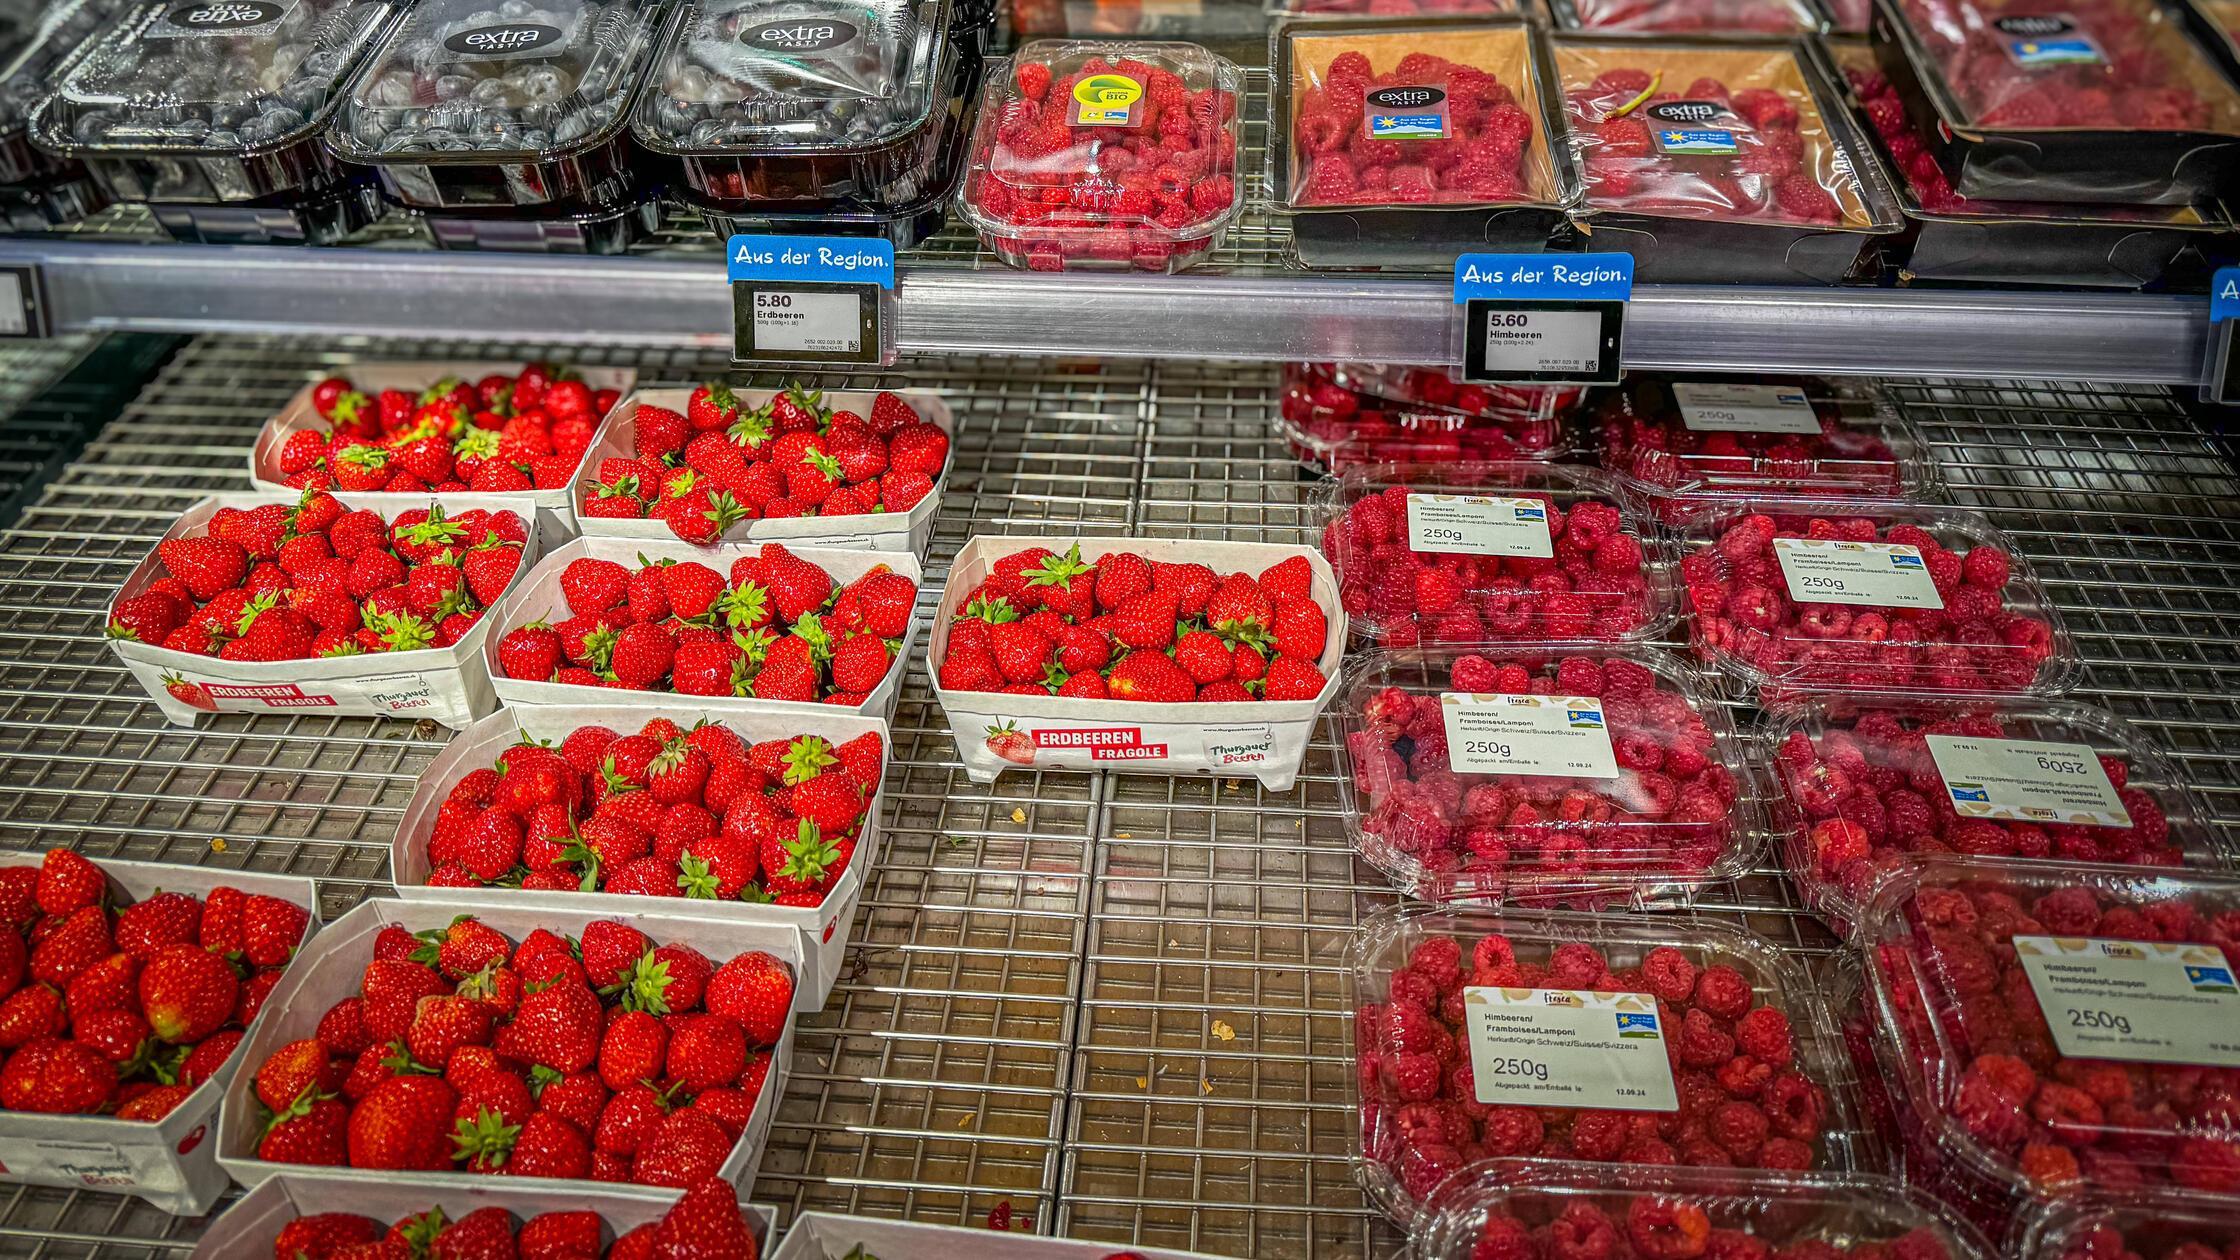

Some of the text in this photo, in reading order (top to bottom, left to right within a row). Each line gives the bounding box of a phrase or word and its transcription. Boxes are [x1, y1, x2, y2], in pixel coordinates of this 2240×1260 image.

[188, 10, 263, 23] extra
[465, 30, 540, 45] extra
[760, 25, 834, 40] extra
[480, 42, 524, 50] TASTY
[1378, 90, 1430, 102] extra
[1659, 104, 1713, 116] extra
[734, 244, 889, 270] Aus der Region.
[1462, 264, 1627, 286] Aus der Region.
[757, 294, 792, 308] 5.80
[757, 310, 805, 320] Erdbeeren
[1491, 314, 1528, 328] 5.60
[1490, 330, 1542, 340] Himbeeren
[1697, 410, 1736, 420] 250g
[1424, 528, 1462, 540] 250g
[1802, 576, 1844, 590] 250g
[207, 686, 297, 698] ERDBEEREN
[372, 688, 430, 703] Thurgauer
[272, 696, 330, 706] FRAGOLE
[389, 698, 431, 710] Beeren
[1040, 732, 1134, 745] ERDBEEREN
[1098, 746, 1161, 758] FRAGOLE
[1210, 742, 1272, 756] Thurgauer
[1464, 740, 1511, 758] 250g
[1222, 752, 1265, 764] Beeren
[2037, 756, 2088, 775] 250g
[1484, 1013, 1533, 1022] Himbeeren/
[2068, 1008, 2132, 1034] 250g
[1486, 1024, 1576, 1036] Framboises/Lamponi
[1493, 1058, 1548, 1080] 250g
[1616, 1088, 1646, 1096] 12.09.24
